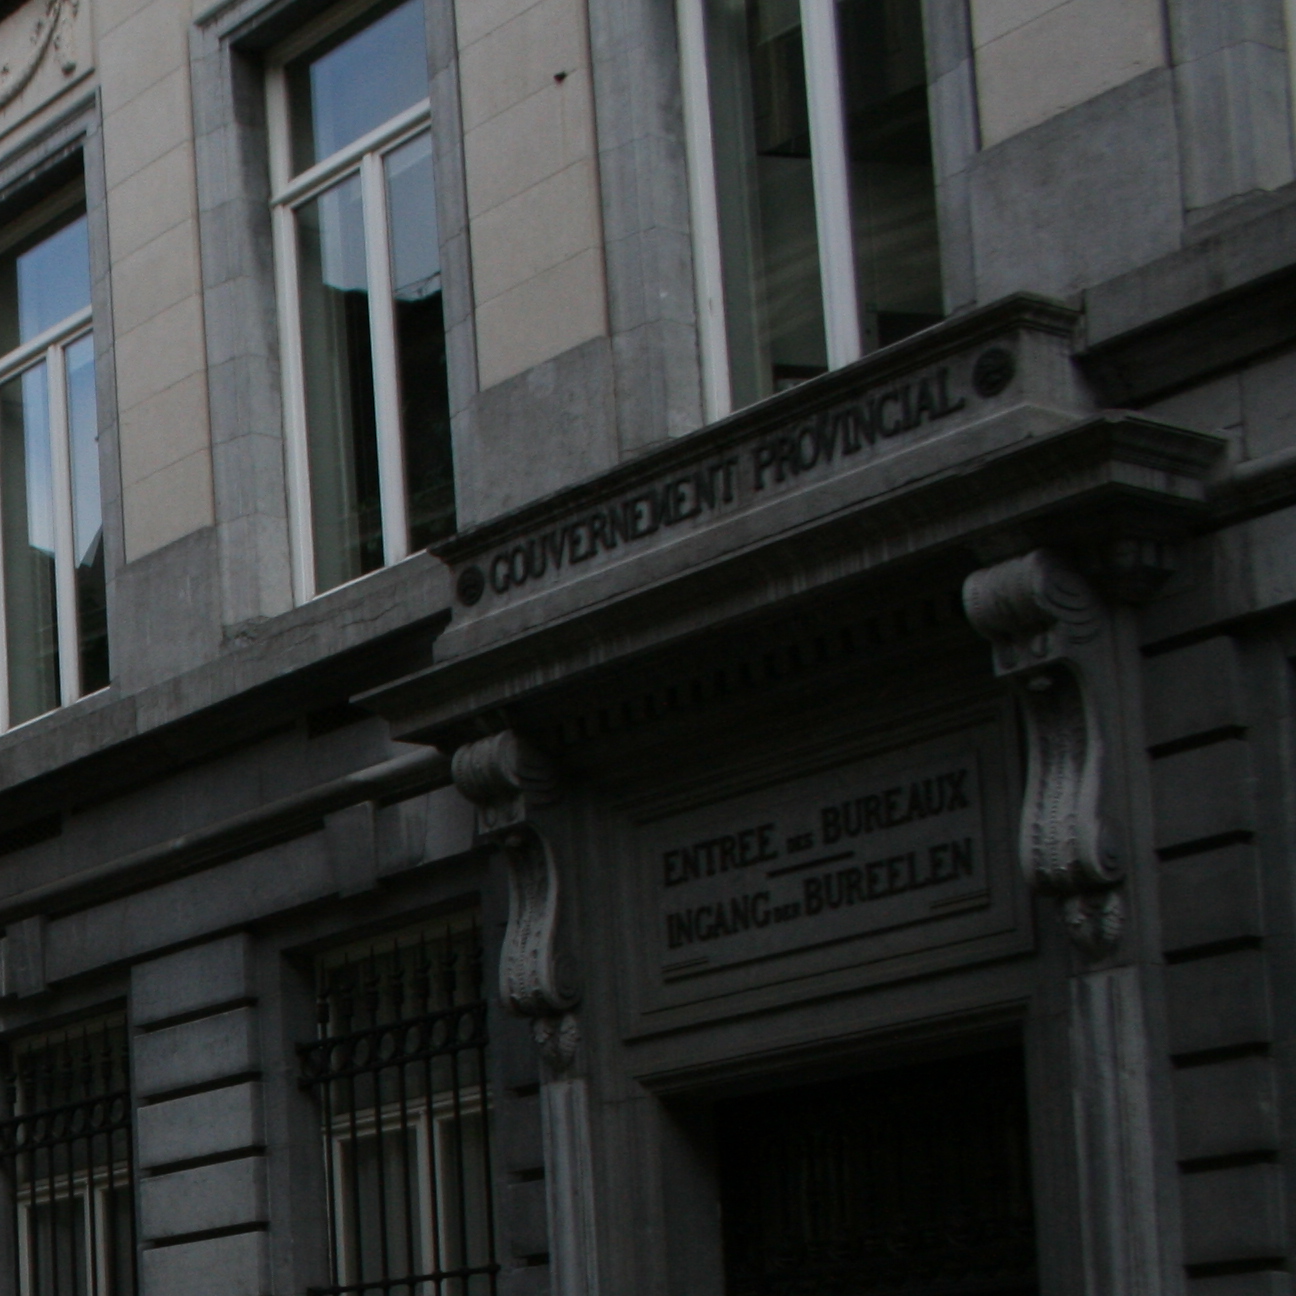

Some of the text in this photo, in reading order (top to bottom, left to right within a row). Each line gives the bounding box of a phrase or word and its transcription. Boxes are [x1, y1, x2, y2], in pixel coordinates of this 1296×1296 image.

[490, 367, 965, 594] GOUVERNEMENT PROVINCIAL
[821, 768, 969, 846] BUREAUX
[667, 891, 772, 949] INGANG
[803, 838, 973, 917] BUREELEN
